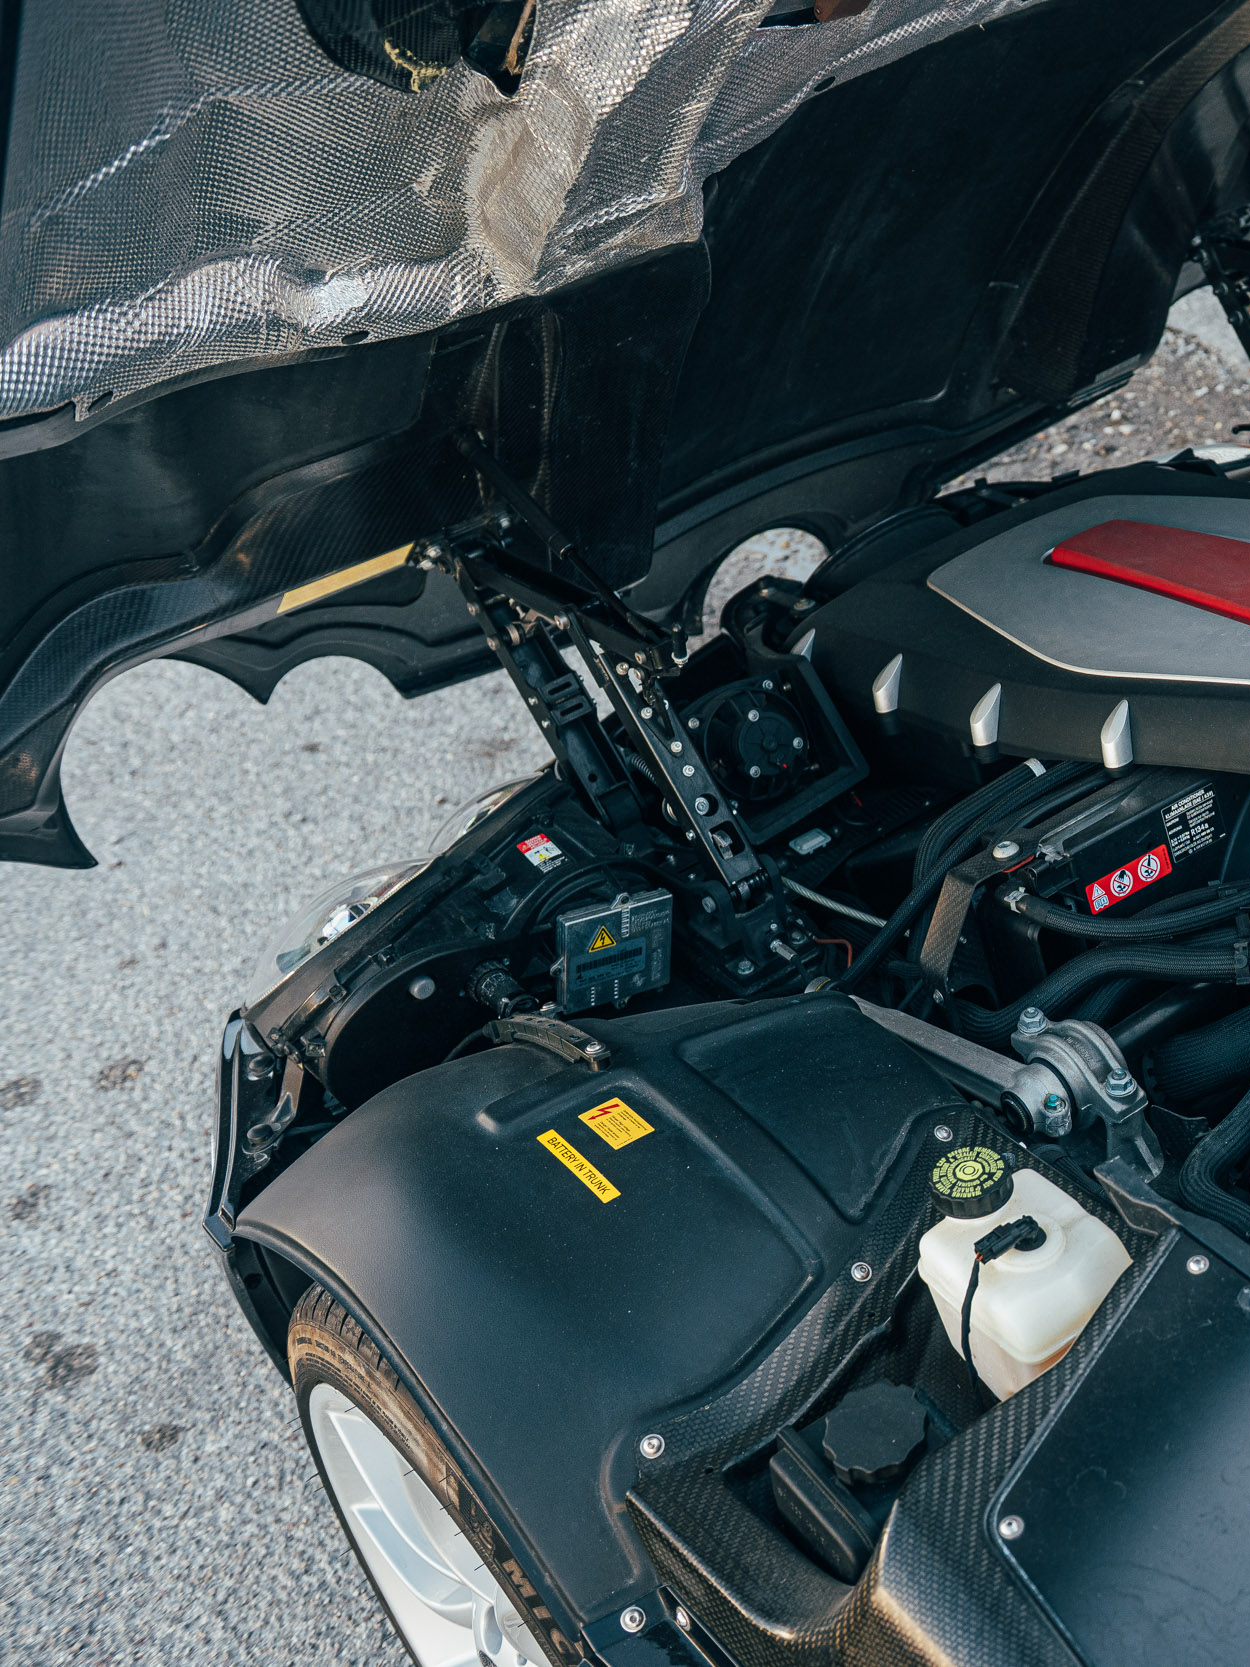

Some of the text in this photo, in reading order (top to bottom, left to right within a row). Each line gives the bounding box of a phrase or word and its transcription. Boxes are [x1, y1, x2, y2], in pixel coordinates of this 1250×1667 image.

[547, 1136, 611, 1195] BATTERY IN TRUNK
